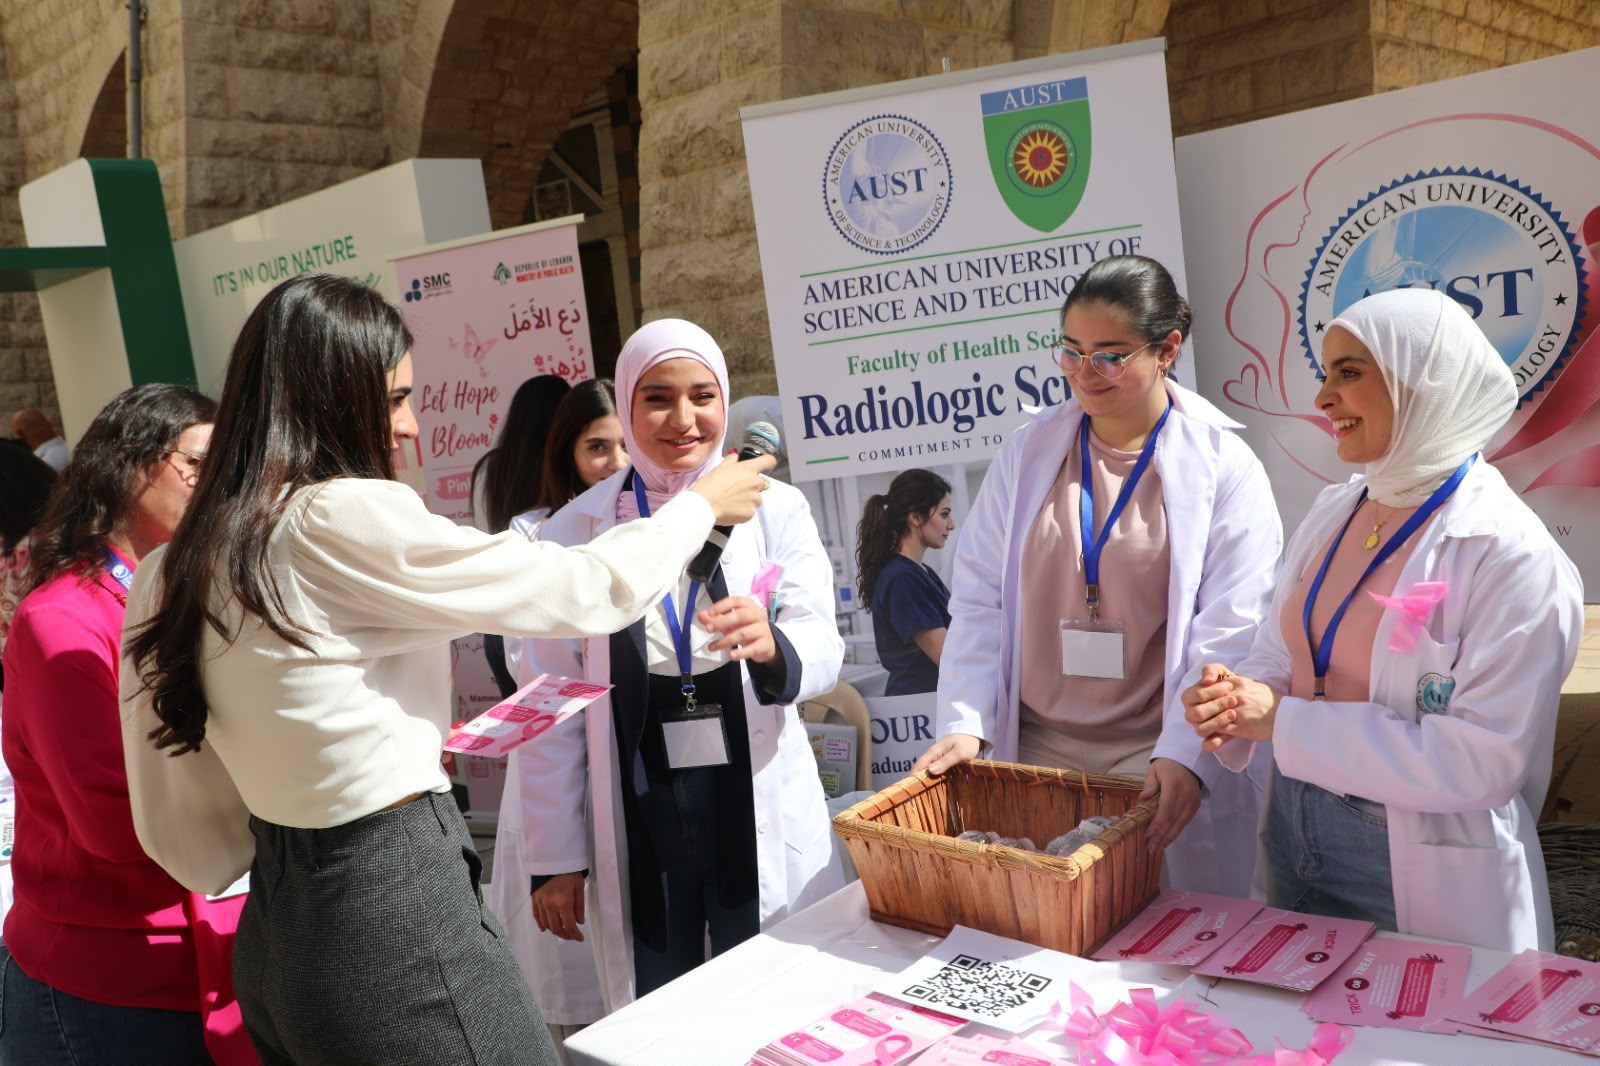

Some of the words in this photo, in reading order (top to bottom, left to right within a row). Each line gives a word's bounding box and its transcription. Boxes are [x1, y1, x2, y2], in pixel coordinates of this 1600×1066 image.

[1003, 81, 1066, 110] AUST
[830, 125, 874, 186] AMERICAN
[877, 122, 944, 169] UNIVERSITY
[848, 167, 929, 204] AUST
[835, 209, 847, 225] OF
[844, 223, 882, 249] SCIENCE
[884, 240, 892, 249] &
[894, 193, 945, 248] TECHNOLOGY
[1315, 189, 1418, 297] AMERICAN
[1426, 183, 1567, 267] UNIVERSITY
[212, 271, 238, 296] IT'S
[239, 265, 255, 288] IN
[257, 256, 289, 283] OUR
[292, 235, 357, 273] NATURE
[423, 272, 451, 289] SMC
[803, 264, 938, 306] AMERICAN
[946, 240, 1101, 283] UNIVERSITY
[1108, 236, 1142, 256] OF
[804, 301, 907, 335] SCIENCE
[913, 291, 968, 318] AND
[973, 273, 1080, 305] TECHNO
[847, 346, 920, 376] Faculty
[927, 343, 950, 365] of
[953, 334, 1021, 361] Health
[1511, 324, 1562, 388] OLOGY
[420, 381, 448, 414] Let
[454, 380, 499, 416] Hope
[797, 372, 1007, 440] Radiologic
[432, 422, 491, 459] Bloom
[858, 437, 972, 463] COMMITMENT
[981, 434, 1004, 447] TO
[871, 714, 935, 745] OUR
[872, 756, 918, 775] aduat
[1323, 929, 1337, 950] TRICK
[1352, 951, 1377, 976] TREAT
[1352, 980, 1362, 989] OR
[1345, 993, 1362, 1015] TRICK
